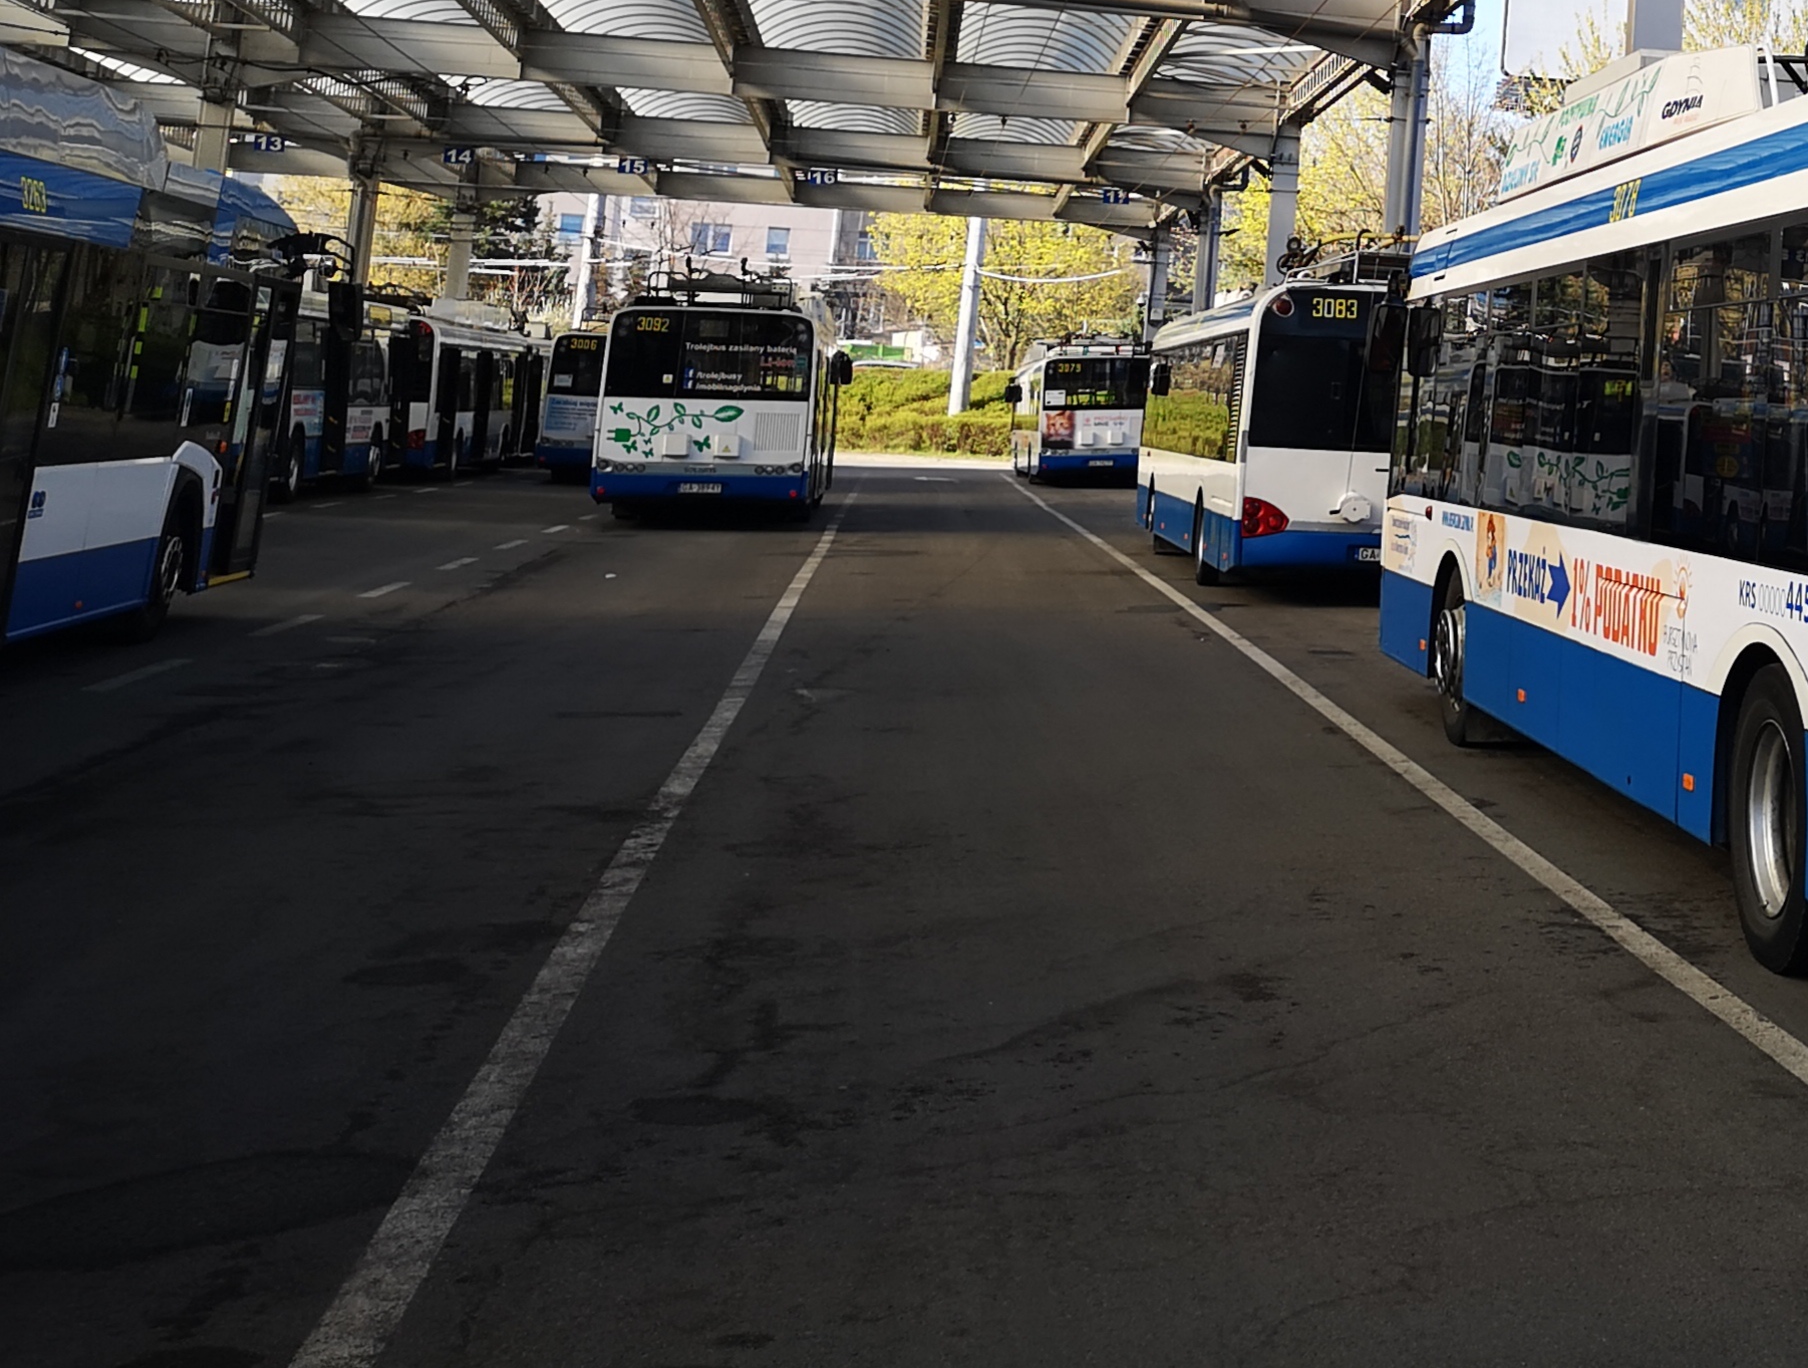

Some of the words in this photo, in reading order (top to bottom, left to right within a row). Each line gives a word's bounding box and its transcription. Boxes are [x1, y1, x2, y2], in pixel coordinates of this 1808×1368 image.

[1661, 94, 1703, 120] GDYNIA
[256, 137, 282, 151] 13
[446, 149, 472, 164] 14
[620, 160, 645, 174] 15
[812, 170, 836, 185] 16
[20, 176, 47, 213] 3263
[1609, 179, 1642, 223] 3078
[1312, 297, 1358, 319] 3083
[637, 316, 670, 332] 3092
[570, 338, 598, 351] 3006
[685, 342, 726, 353] Trolejbus
[1507, 546, 1547, 605] PRZEKAŻ
[1571, 557, 1591, 633] 1%
[1594, 563, 1664, 657] PODATKU
[1739, 579, 1756, 610] KRS
